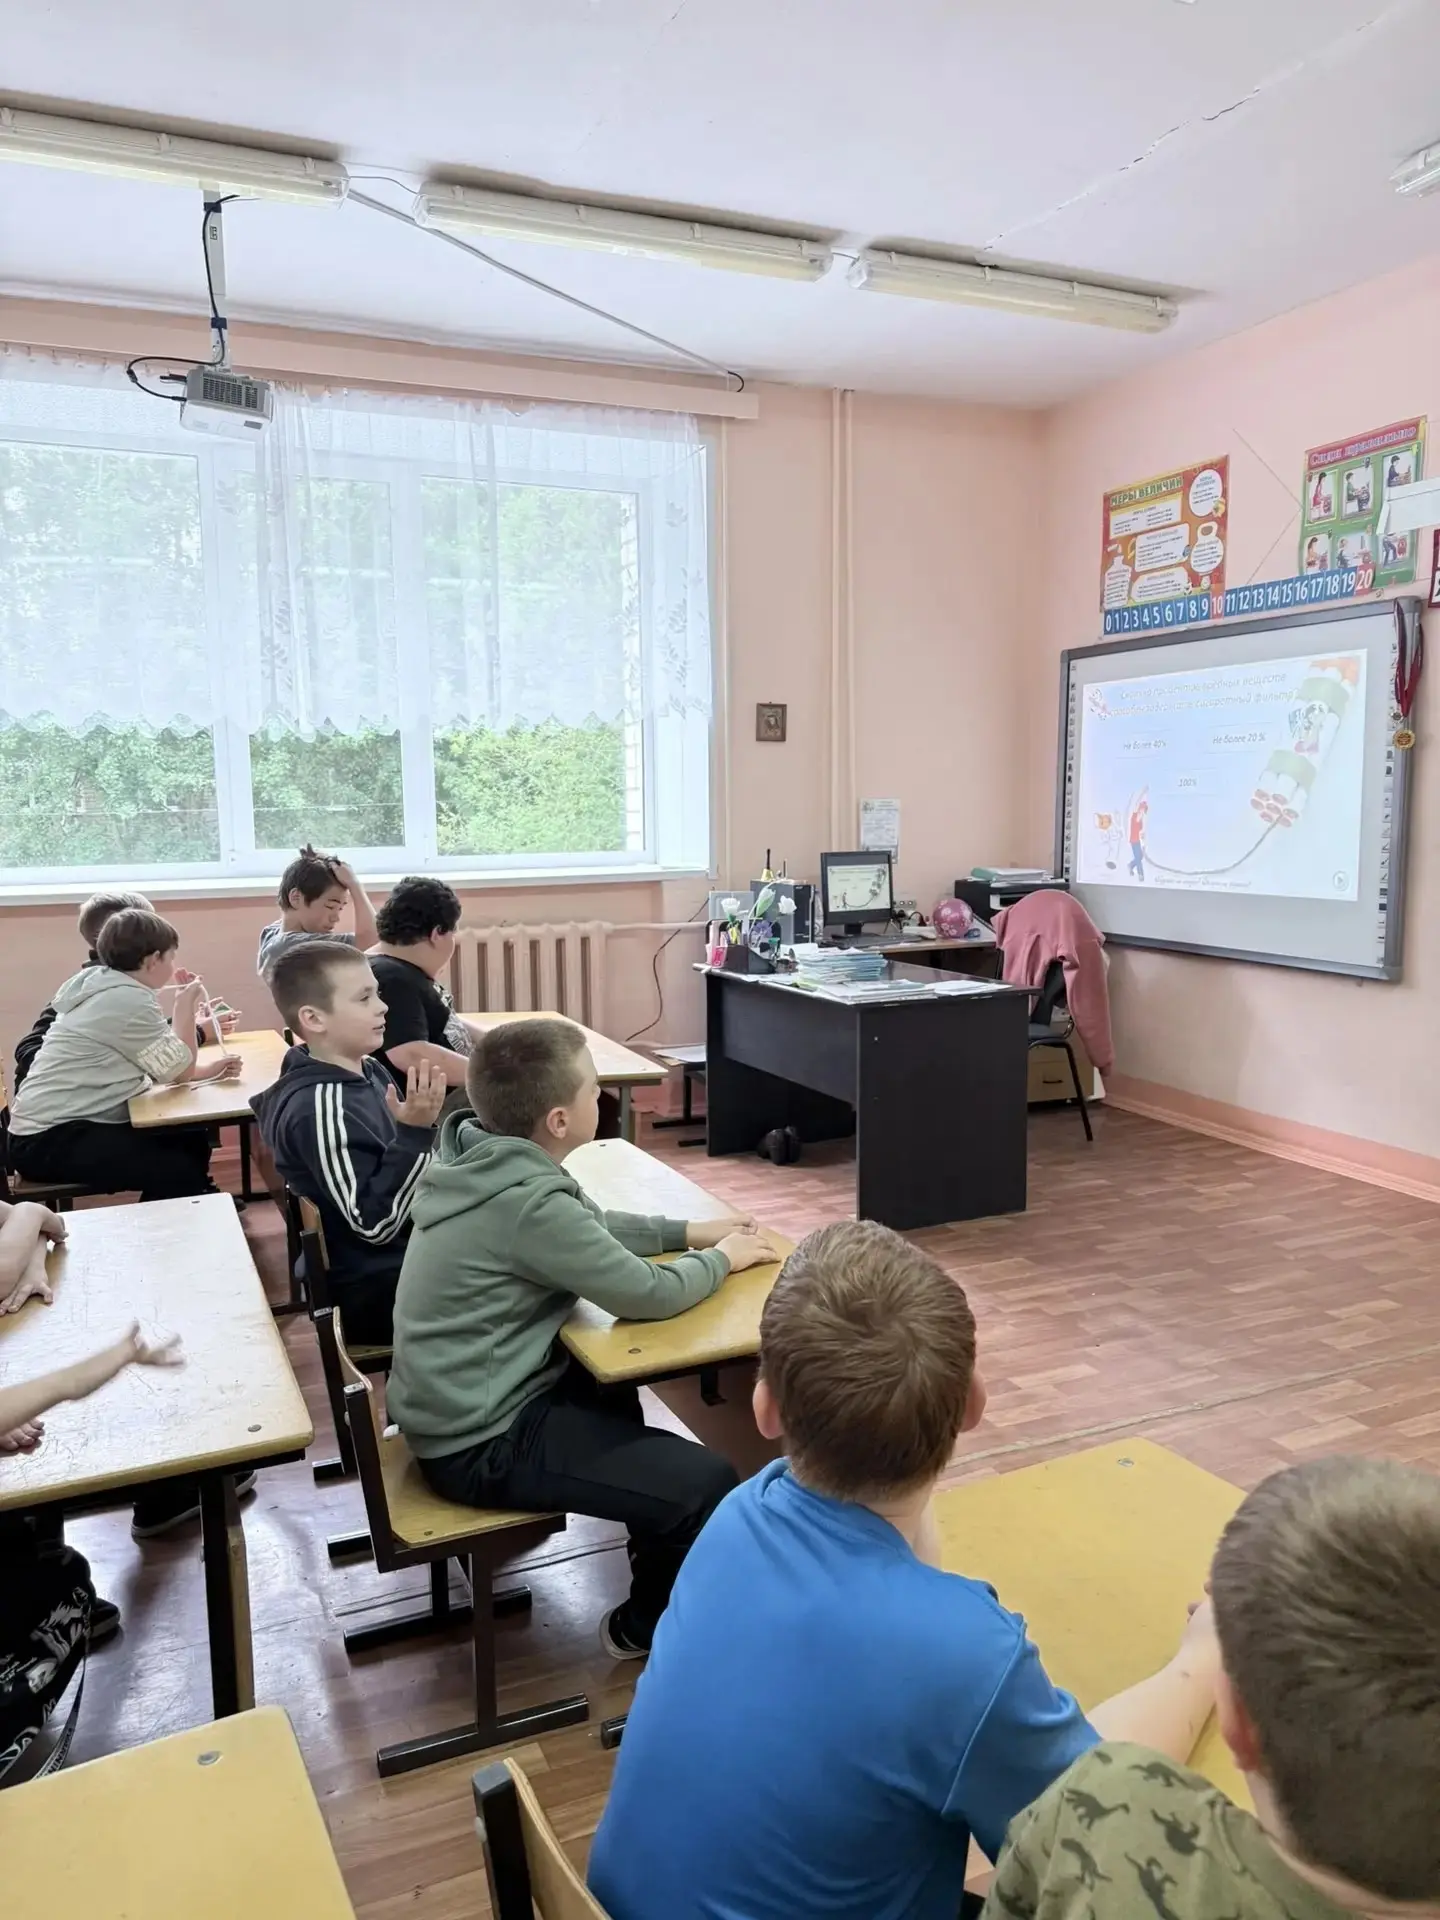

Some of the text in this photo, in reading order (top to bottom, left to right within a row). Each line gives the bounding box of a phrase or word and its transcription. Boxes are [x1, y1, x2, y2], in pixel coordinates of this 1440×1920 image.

[1344, 427, 1416, 456] правильно
[1111, 490, 1137, 505] МЕРЫ
[1139, 476, 1184, 498] ВЕЛИЧИН
[1106, 569, 1373, 631] 0 1 2 3 4 5 6 7 8 9 10 11 12 13 14 15 16 17 18 19 20
[1133, 740, 1151, 750] более
[1212, 736, 1222, 745] Не
[1222, 734, 1246, 744] более
[1248, 733, 1258, 742] 20
[1178, 778, 1198, 787] 100%
